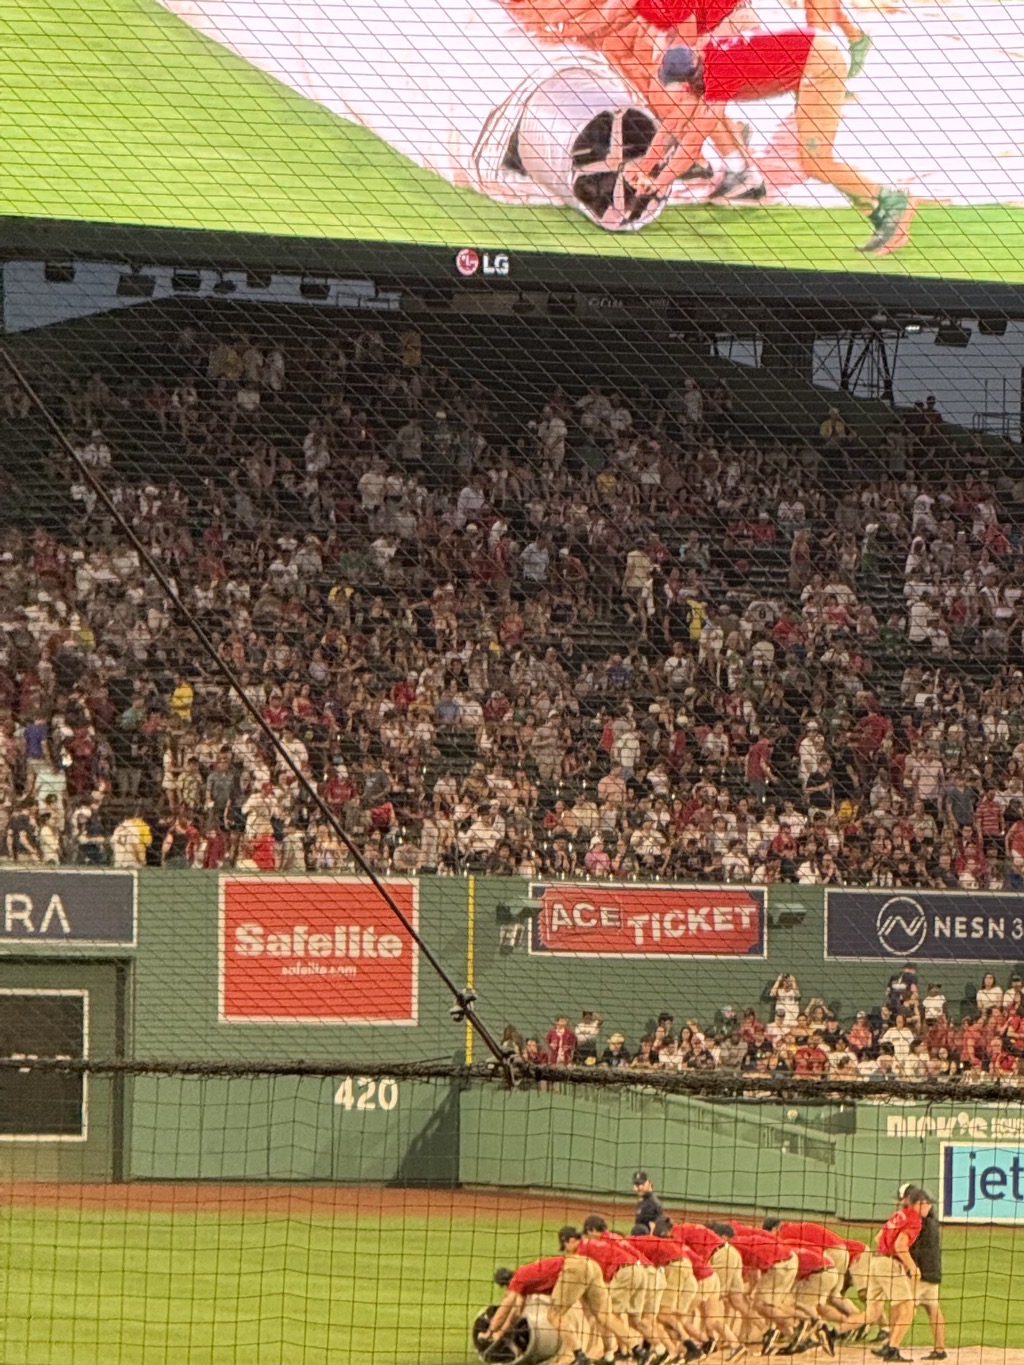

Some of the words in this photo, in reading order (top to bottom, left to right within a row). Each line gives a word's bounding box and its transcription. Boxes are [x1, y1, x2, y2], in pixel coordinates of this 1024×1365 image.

[482, 253, 510, 275] LG
[234, 922, 403, 958] Safelite
[550, 901, 623, 933] ACE
[626, 904, 757, 946] TICKET
[934, 916, 1005, 939] NESN
[335, 1077, 399, 1111] 420
